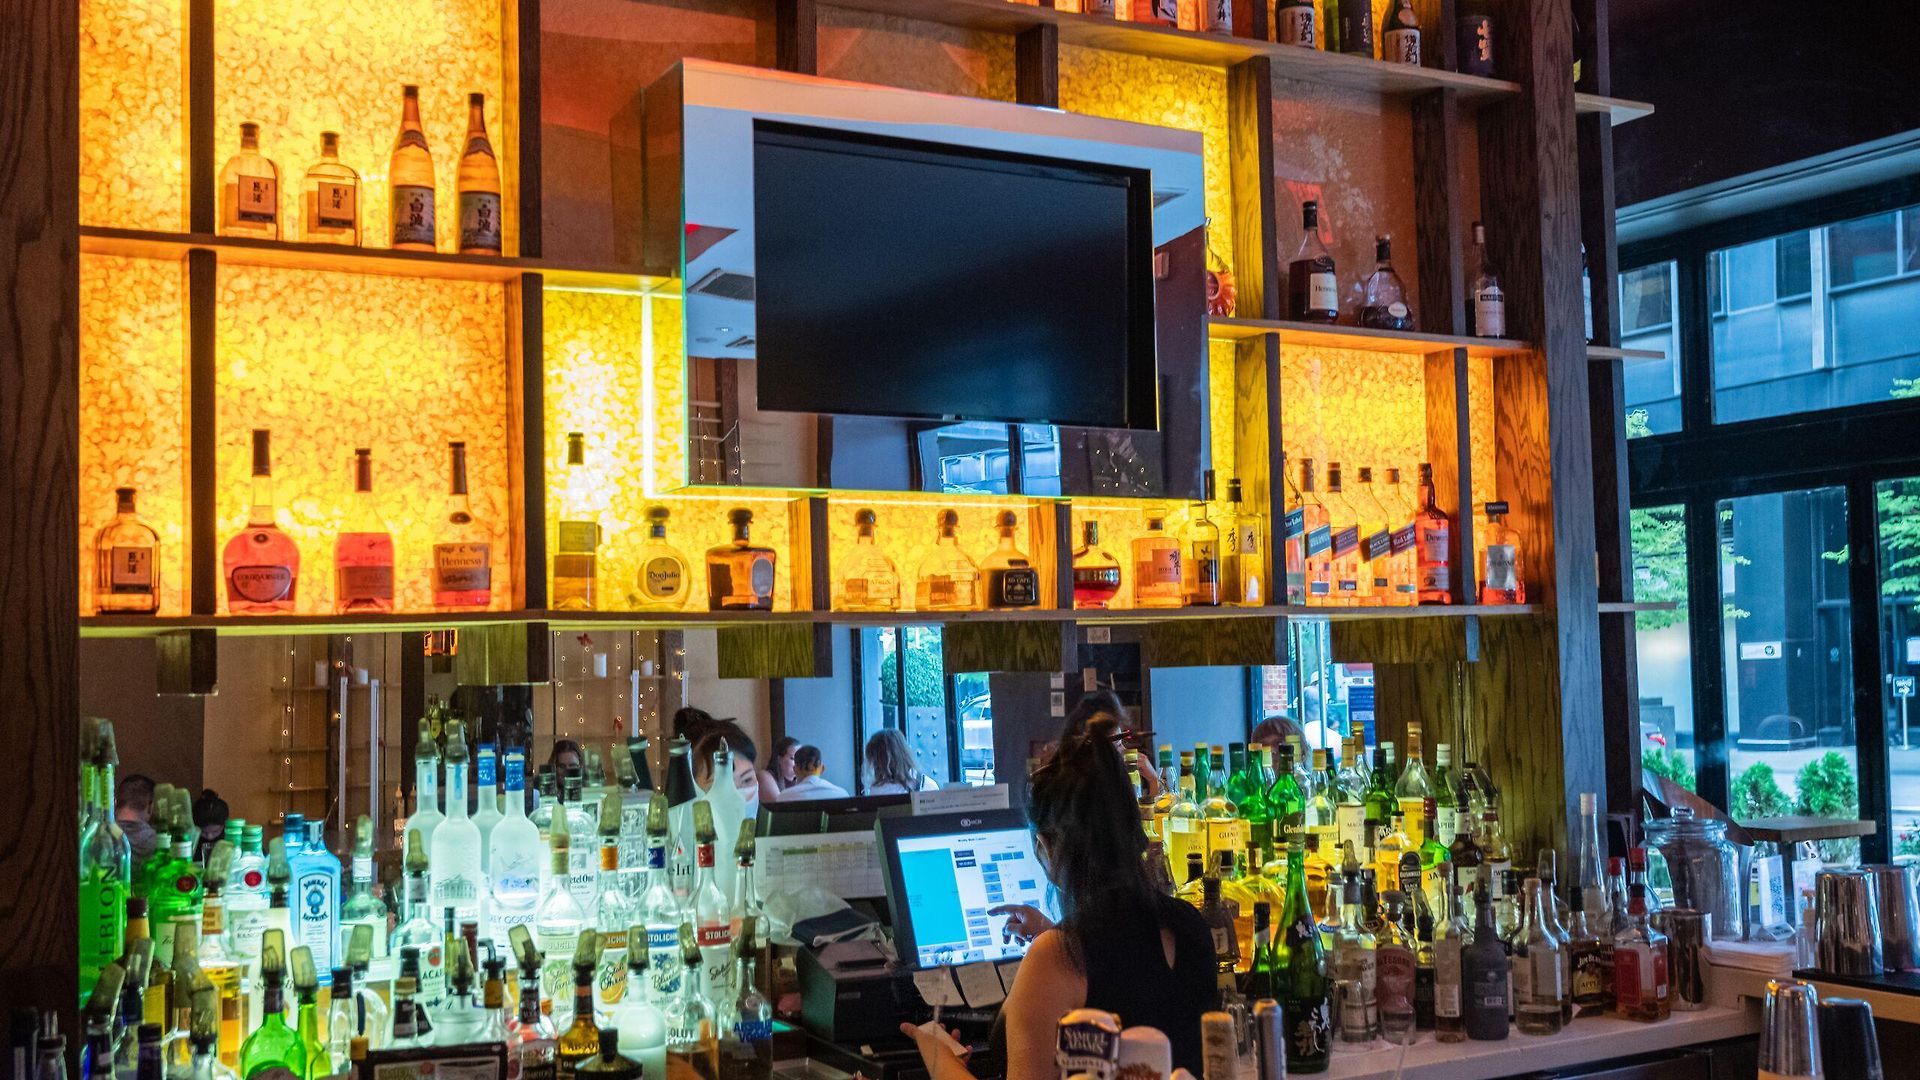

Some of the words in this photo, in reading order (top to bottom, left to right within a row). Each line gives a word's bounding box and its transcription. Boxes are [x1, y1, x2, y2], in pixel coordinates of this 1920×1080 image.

[441, 556, 482, 567] Hennessy
[668, 863, 690, 876] elit
[569, 873, 582, 884] etel
[582, 873, 594, 884] One
[303, 879, 327, 890] BOMBAY
[99, 865, 116, 972] EBLON
[302, 911, 329, 922] SAPPHIRE
[504, 914, 535, 925] GOOSE
[1063, 1026, 1105, 1044] SAMUEL
[1066, 1038, 1104, 1055] ADAMS
